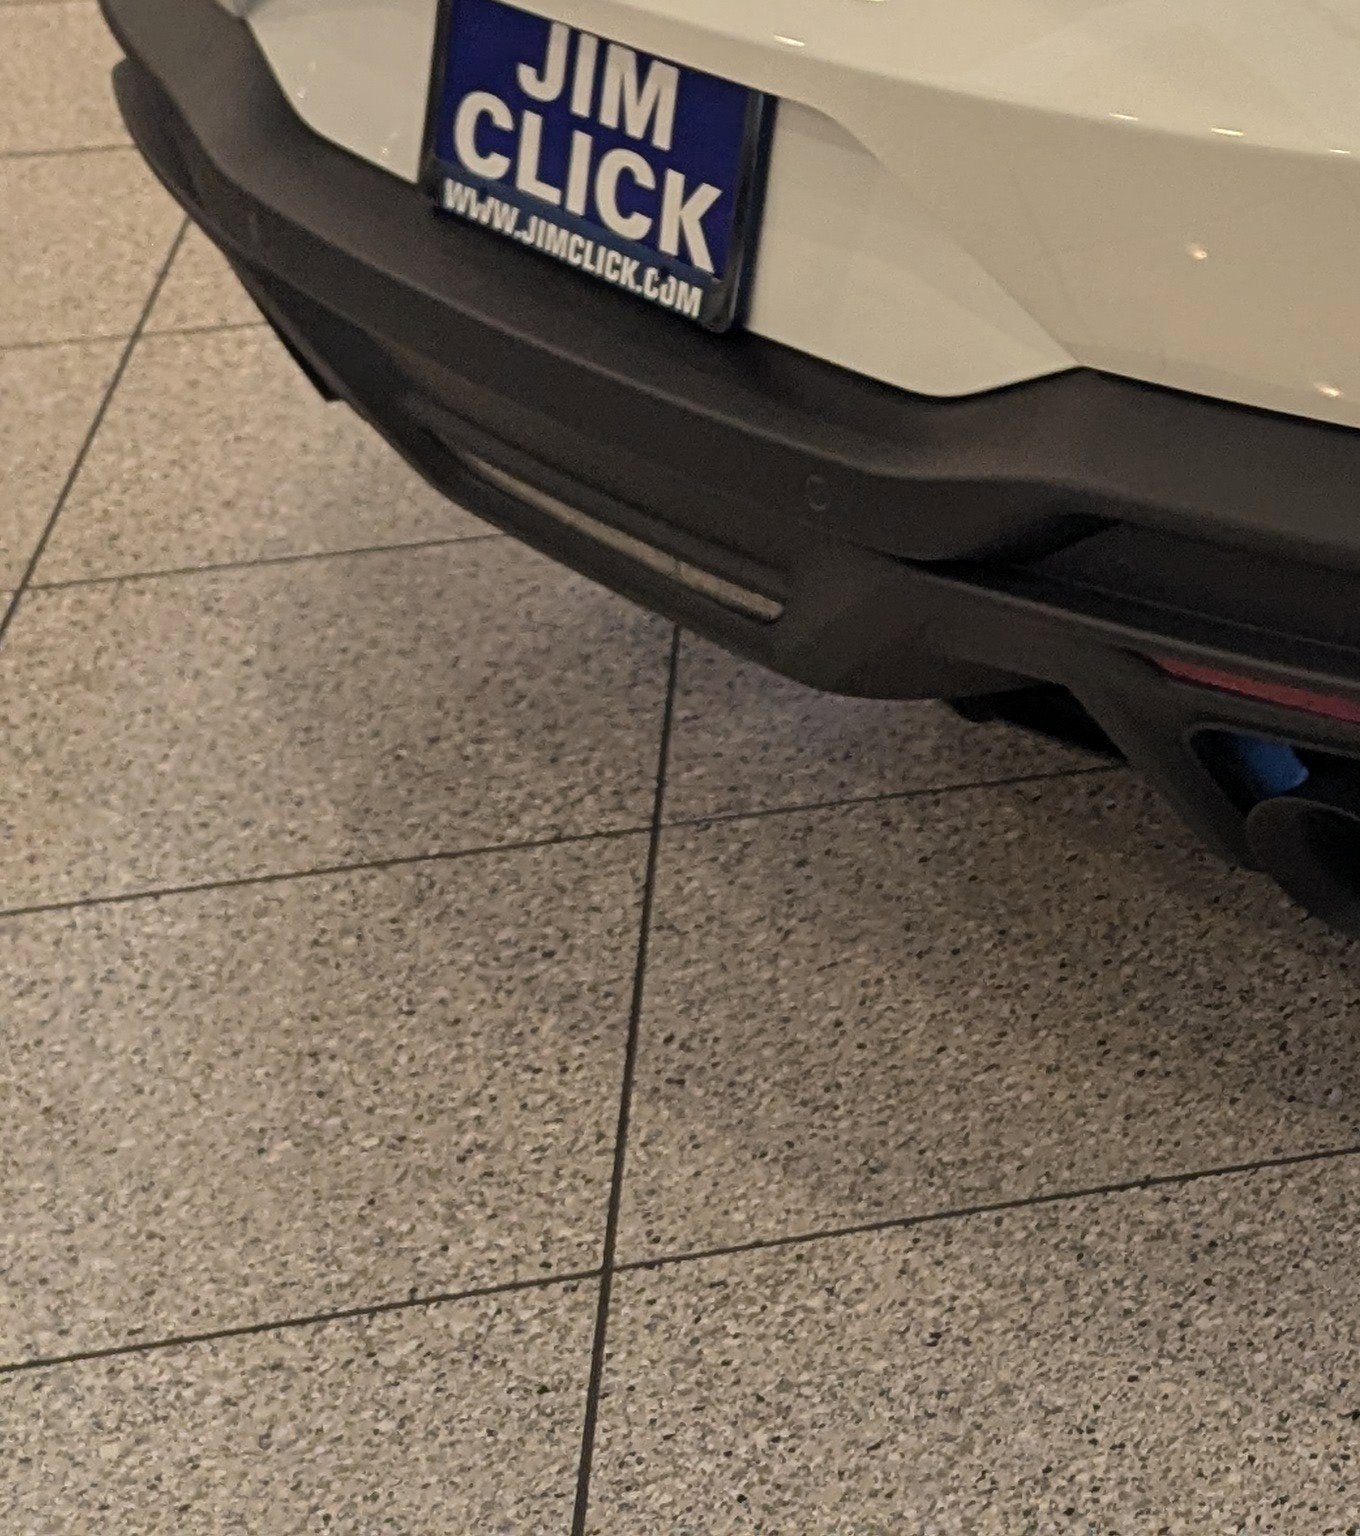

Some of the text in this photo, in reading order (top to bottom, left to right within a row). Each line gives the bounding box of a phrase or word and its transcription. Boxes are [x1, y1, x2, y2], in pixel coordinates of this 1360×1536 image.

[516, 20, 680, 152] JIM
[442, 176, 705, 321] WWW.JIMCLICK.COM
[453, 89, 723, 275] CLICK
